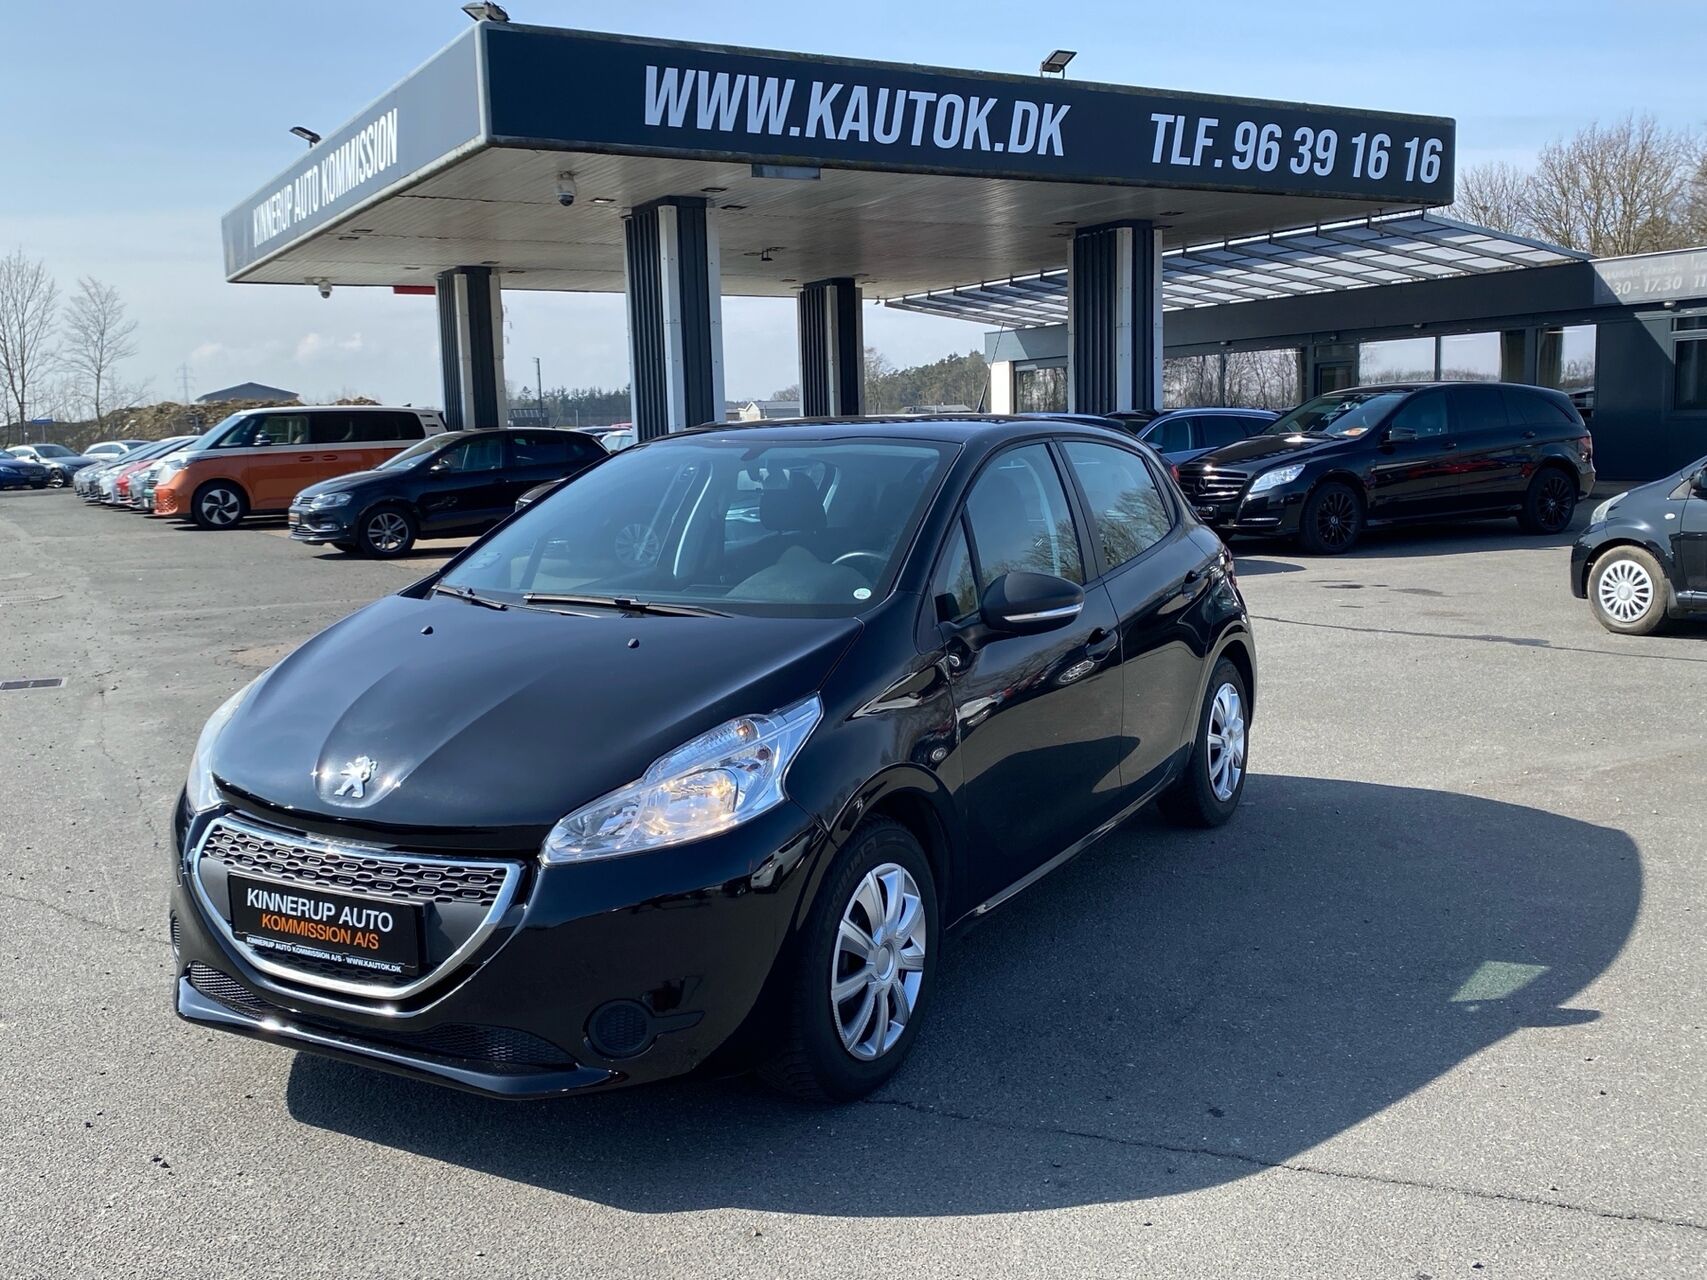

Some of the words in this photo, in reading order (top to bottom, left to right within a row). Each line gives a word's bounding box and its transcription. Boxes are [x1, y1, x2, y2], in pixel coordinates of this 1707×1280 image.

[644, 65, 1071, 157] WWW.KAUTOK.DK
[1150, 113, 1223, 168] TLF.
[1232, 121, 1282, 172] 96
[1290, 127, 1338, 177] 39
[1351, 132, 1391, 180] 16
[1404, 137, 1443, 184] 16
[253, 184, 292, 248] KINNERUP
[294, 165, 319, 223] AUTO
[321, 108, 398, 207] KOMMISSION
[1644, 276, 1682, 293] 17.30
[247, 888, 335, 921] KINNERUP
[339, 906, 393, 932] AUTO
[262, 914, 350, 944] KOMMISSION
[353, 931, 379, 950] A/S
[246, 936, 274, 948] KINNERUP
[275, 942, 291, 952] AUTO
[292, 946, 330, 960] KOMMISSION
[331, 953, 342, 962] A/S
[346, 956, 402, 973] WWW.KAUTOK.DK
